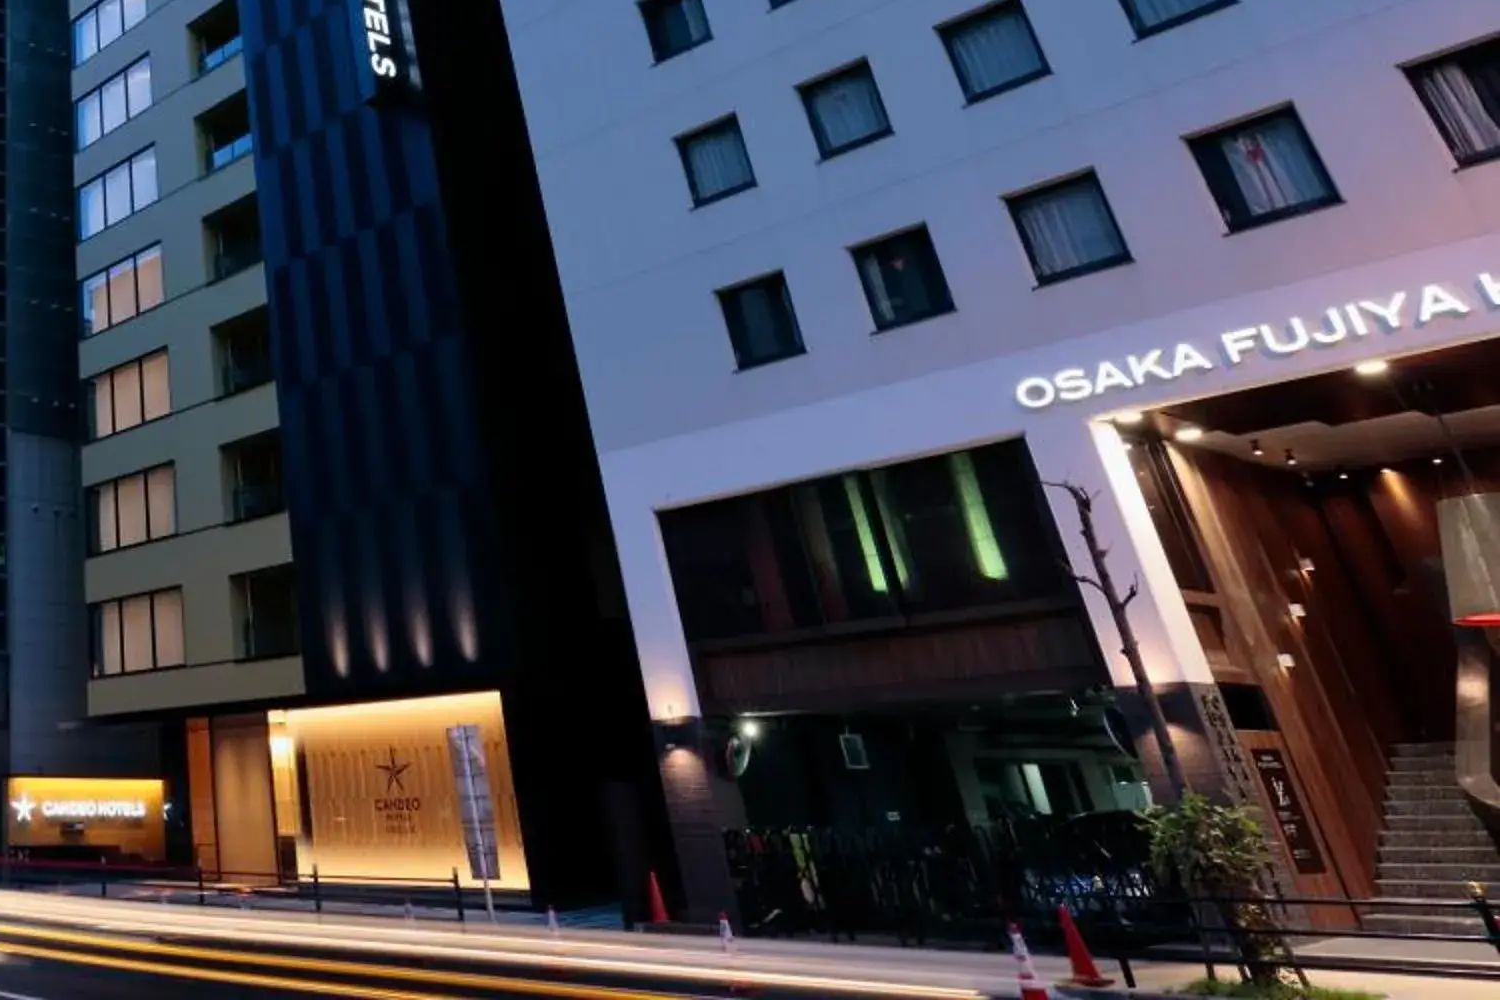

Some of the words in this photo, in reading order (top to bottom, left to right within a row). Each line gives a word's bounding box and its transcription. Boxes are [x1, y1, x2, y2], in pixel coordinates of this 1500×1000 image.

[1015, 342, 1213, 409] OSAKA
[1221, 284, 1470, 365] FUJIYA
[374, 797, 421, 812] CANDEO
